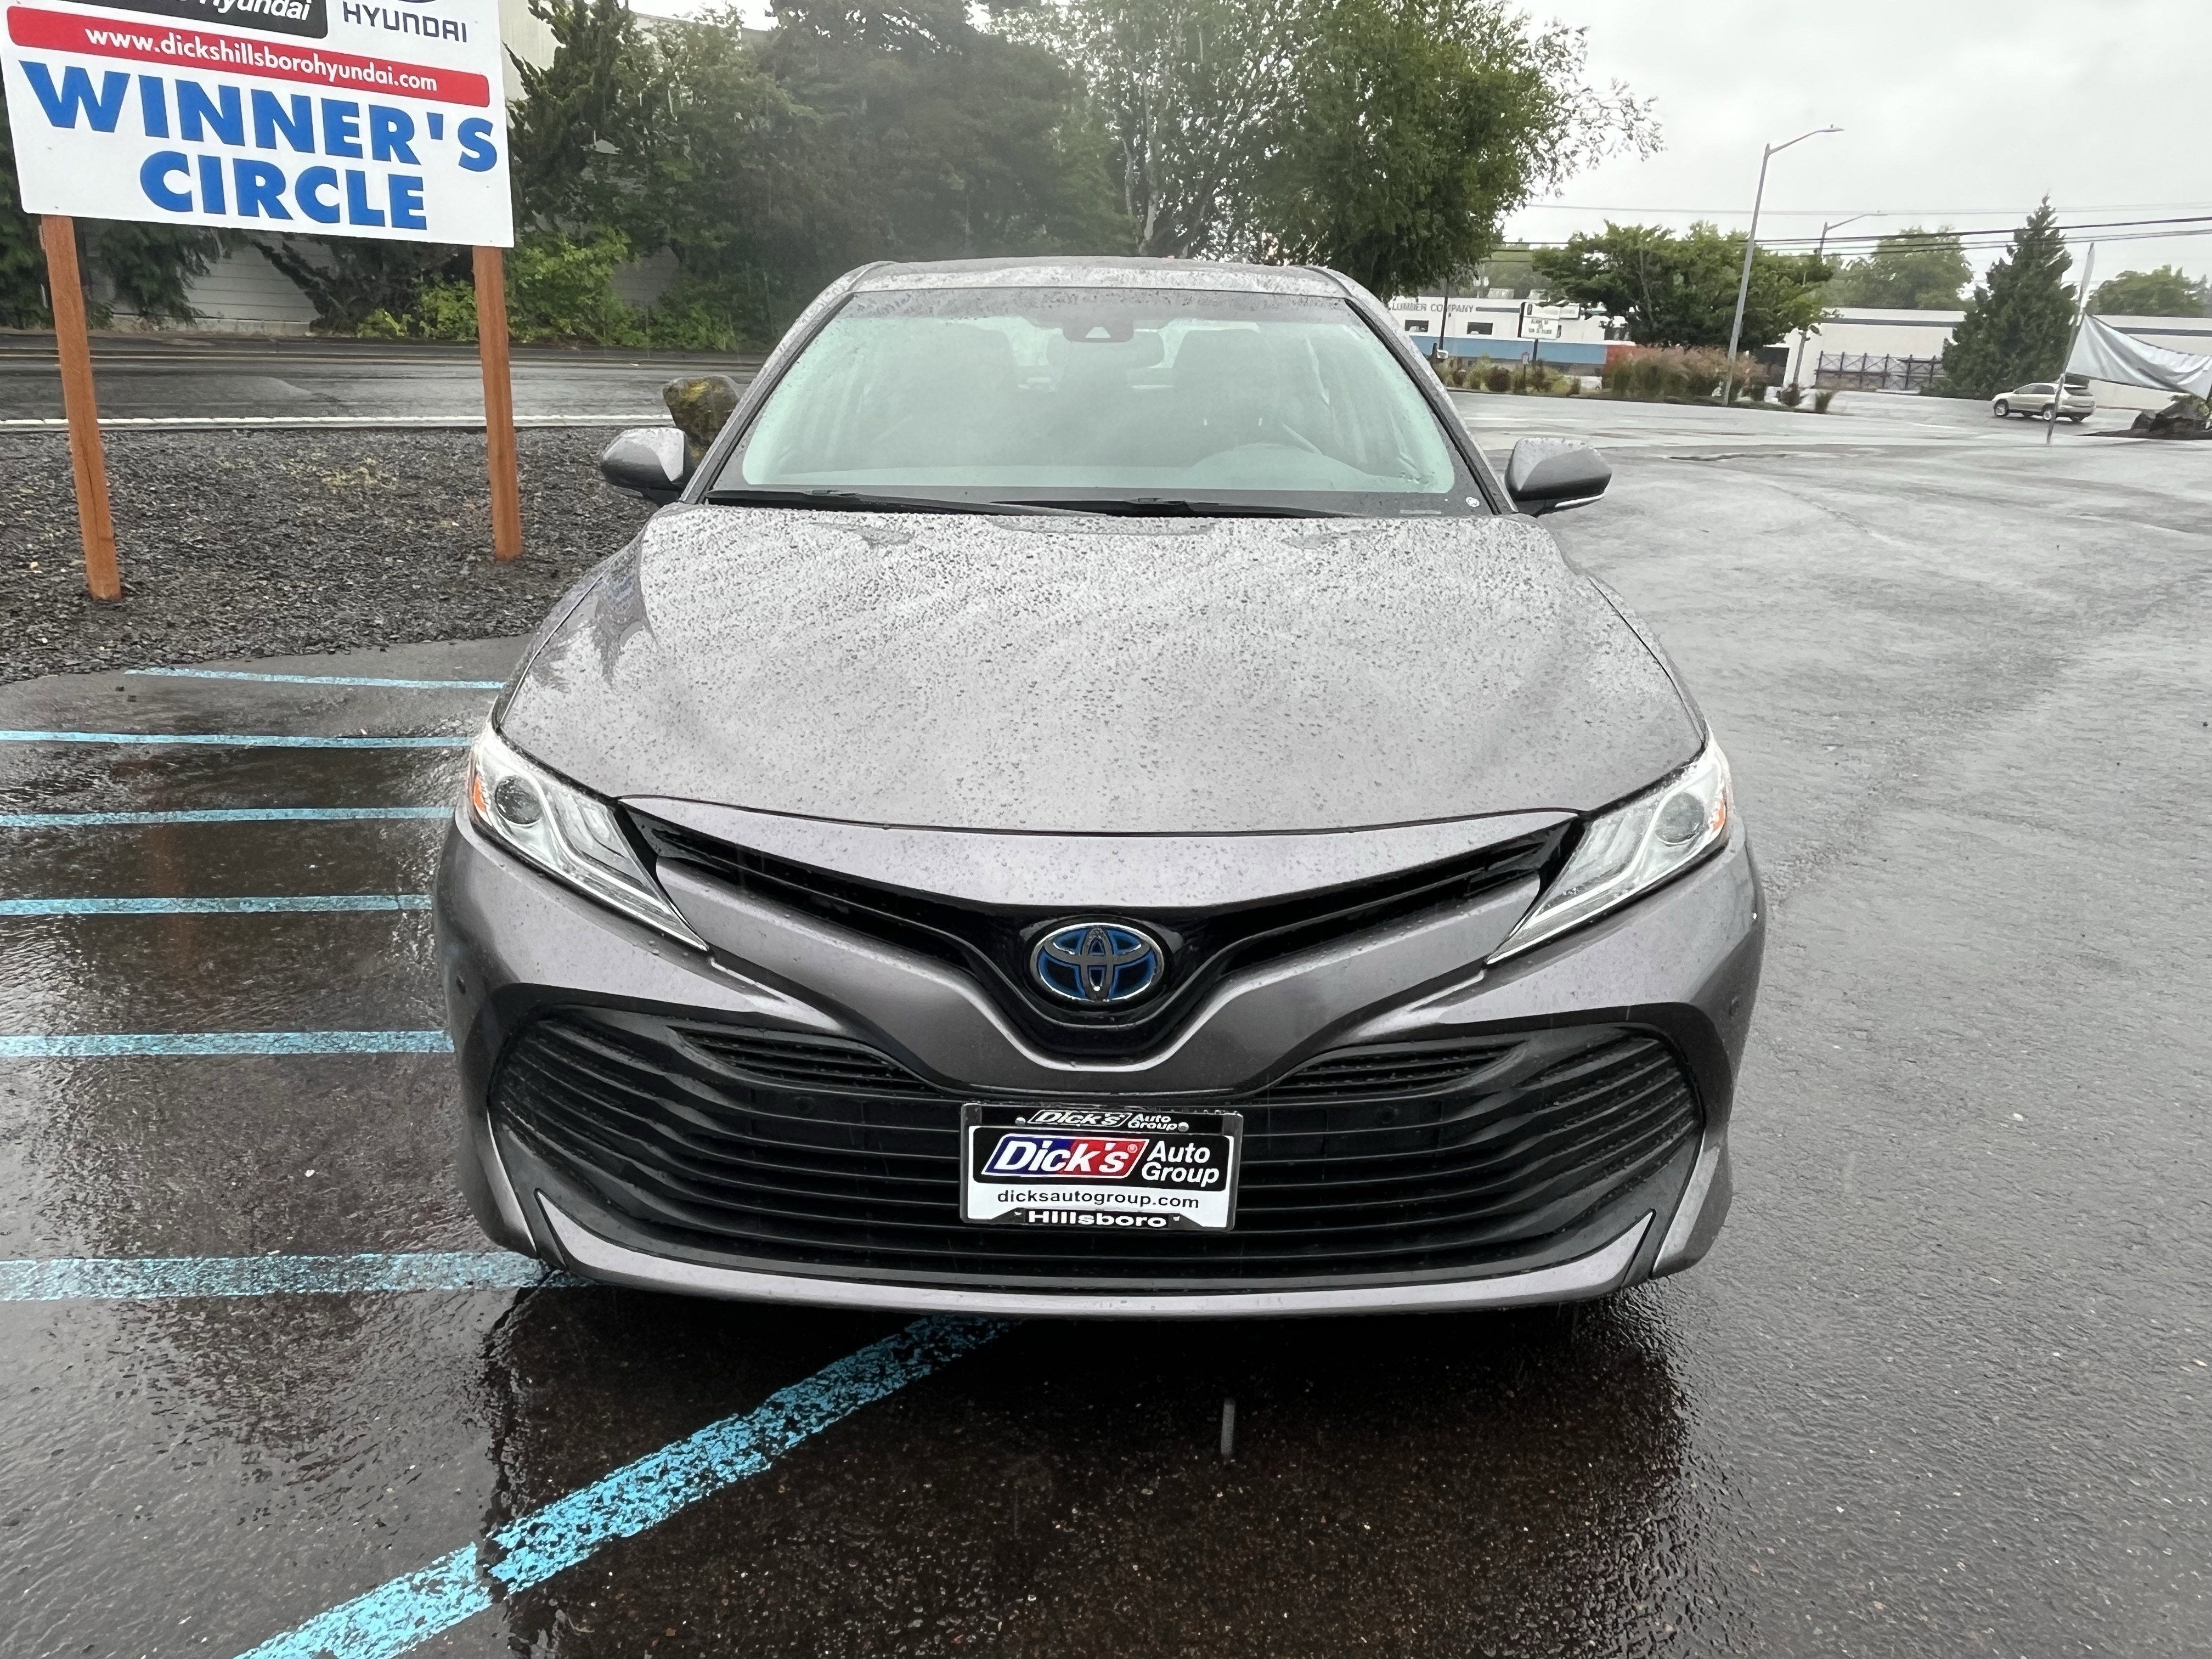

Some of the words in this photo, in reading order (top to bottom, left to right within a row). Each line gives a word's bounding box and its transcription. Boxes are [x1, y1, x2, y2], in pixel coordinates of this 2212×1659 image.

[200, 0, 312, 20] yundai
[343, 1, 467, 42] HYUNDAI
[84, 26, 438, 92] www.dickshillsborohyundai.com
[19, 60, 497, 172] WINNER'S
[140, 151, 428, 230] CIRCLE
[1127, 1119, 1177, 1131] Group
[1133, 1113, 1171, 1123] Auto
[994, 1140, 1128, 1173] Dick's
[1147, 1140, 1211, 1164] Auto
[1142, 1161, 1220, 1188] Group
[997, 1189, 1199, 1209] dicksautogroup.com
[1028, 1210, 1167, 1228] Hillsboro
